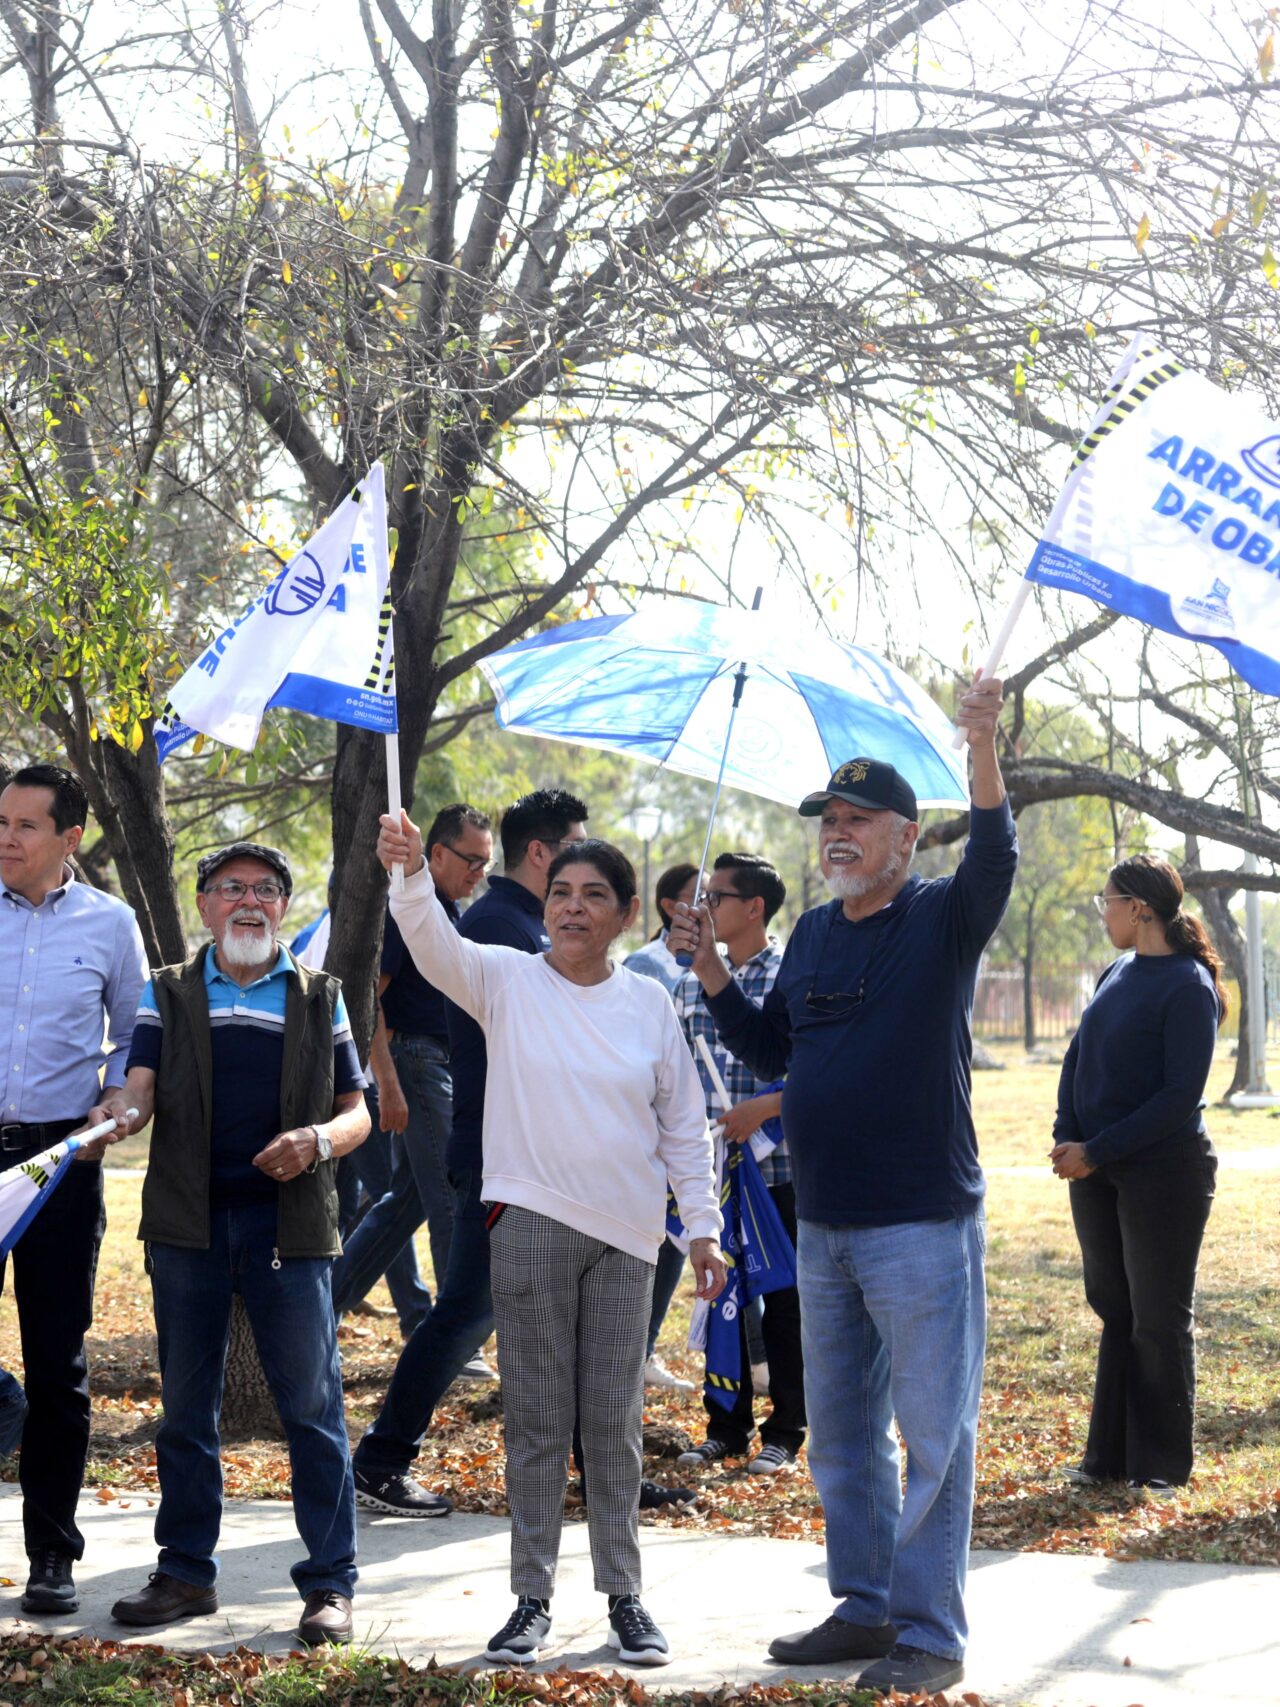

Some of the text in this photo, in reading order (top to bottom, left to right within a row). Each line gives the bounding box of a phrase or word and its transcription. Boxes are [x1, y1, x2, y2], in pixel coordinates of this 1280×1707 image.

[1151, 482, 1214, 534] DE
[1041, 555, 1066, 568] Obras
[1037, 563, 1113, 600] Desarrollo Urbano
